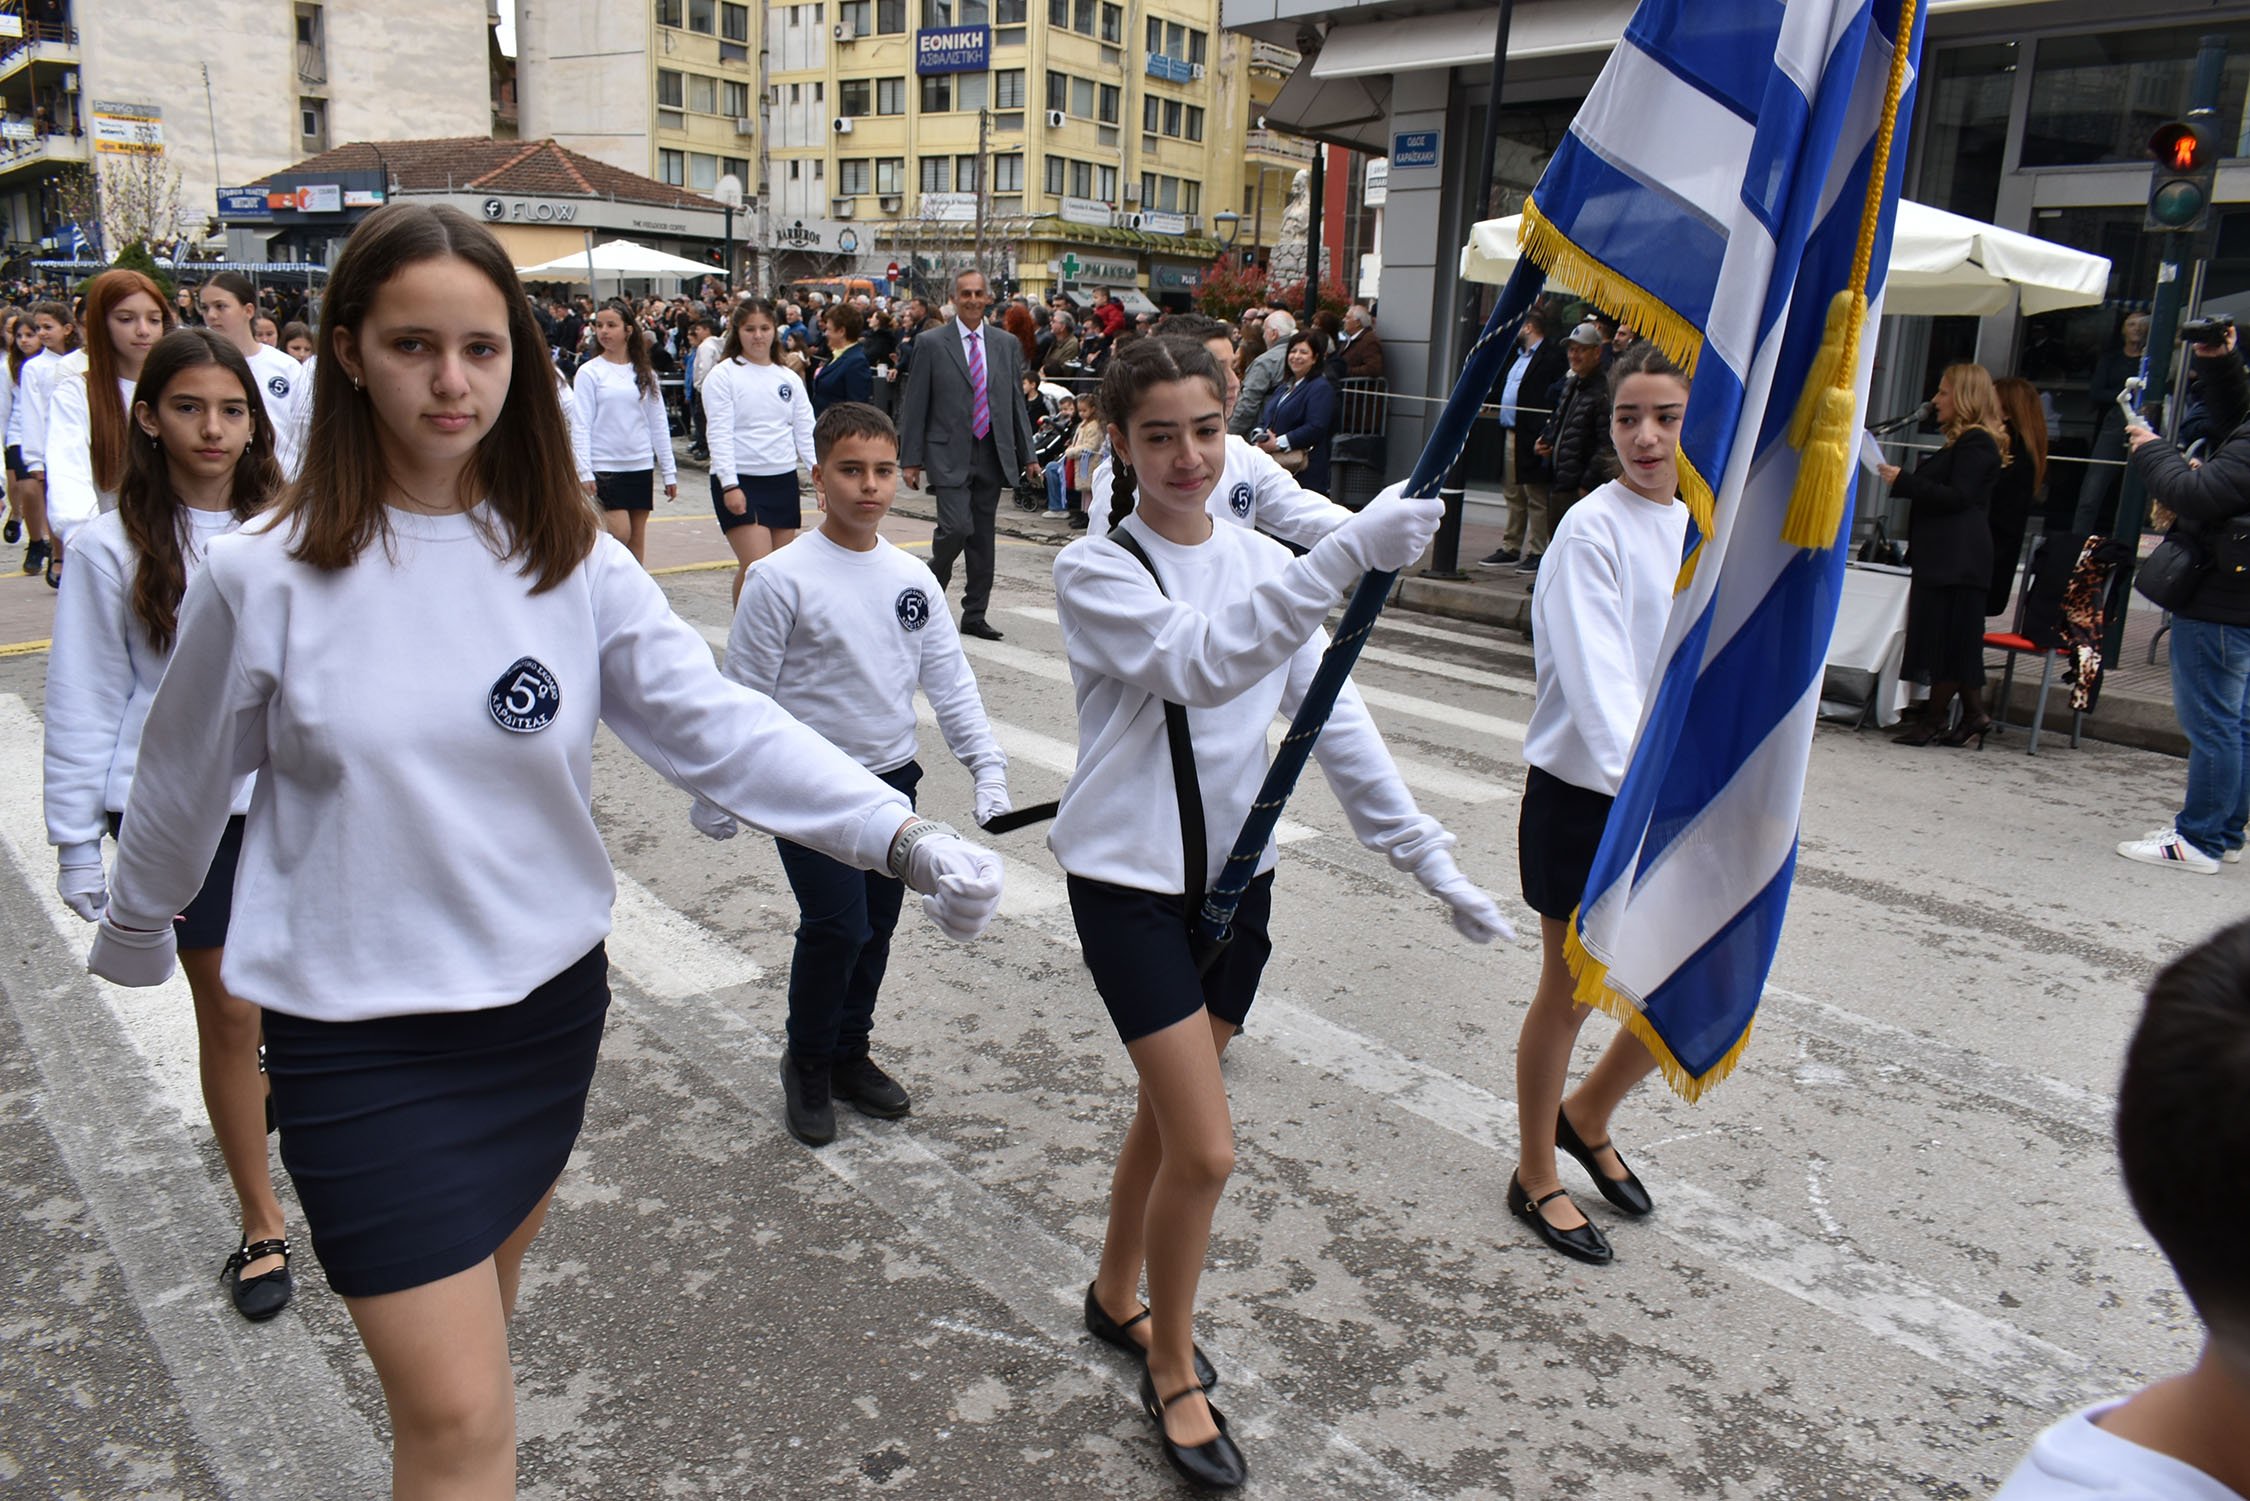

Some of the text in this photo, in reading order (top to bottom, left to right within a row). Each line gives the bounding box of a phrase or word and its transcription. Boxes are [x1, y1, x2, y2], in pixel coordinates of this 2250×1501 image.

[920, 31, 984, 52] ΕΘΝΙΚΗ
[920, 49, 984, 66] ΑΣΦΑΛΙΣΤΙΚΗ
[511, 202, 578, 222] FLOW
[1078, 262, 1137, 280] ΡΜΑΚΕΙΟ
[493, 693, 548, 728] ΚΑΡΔΙΤΣΑΣ
